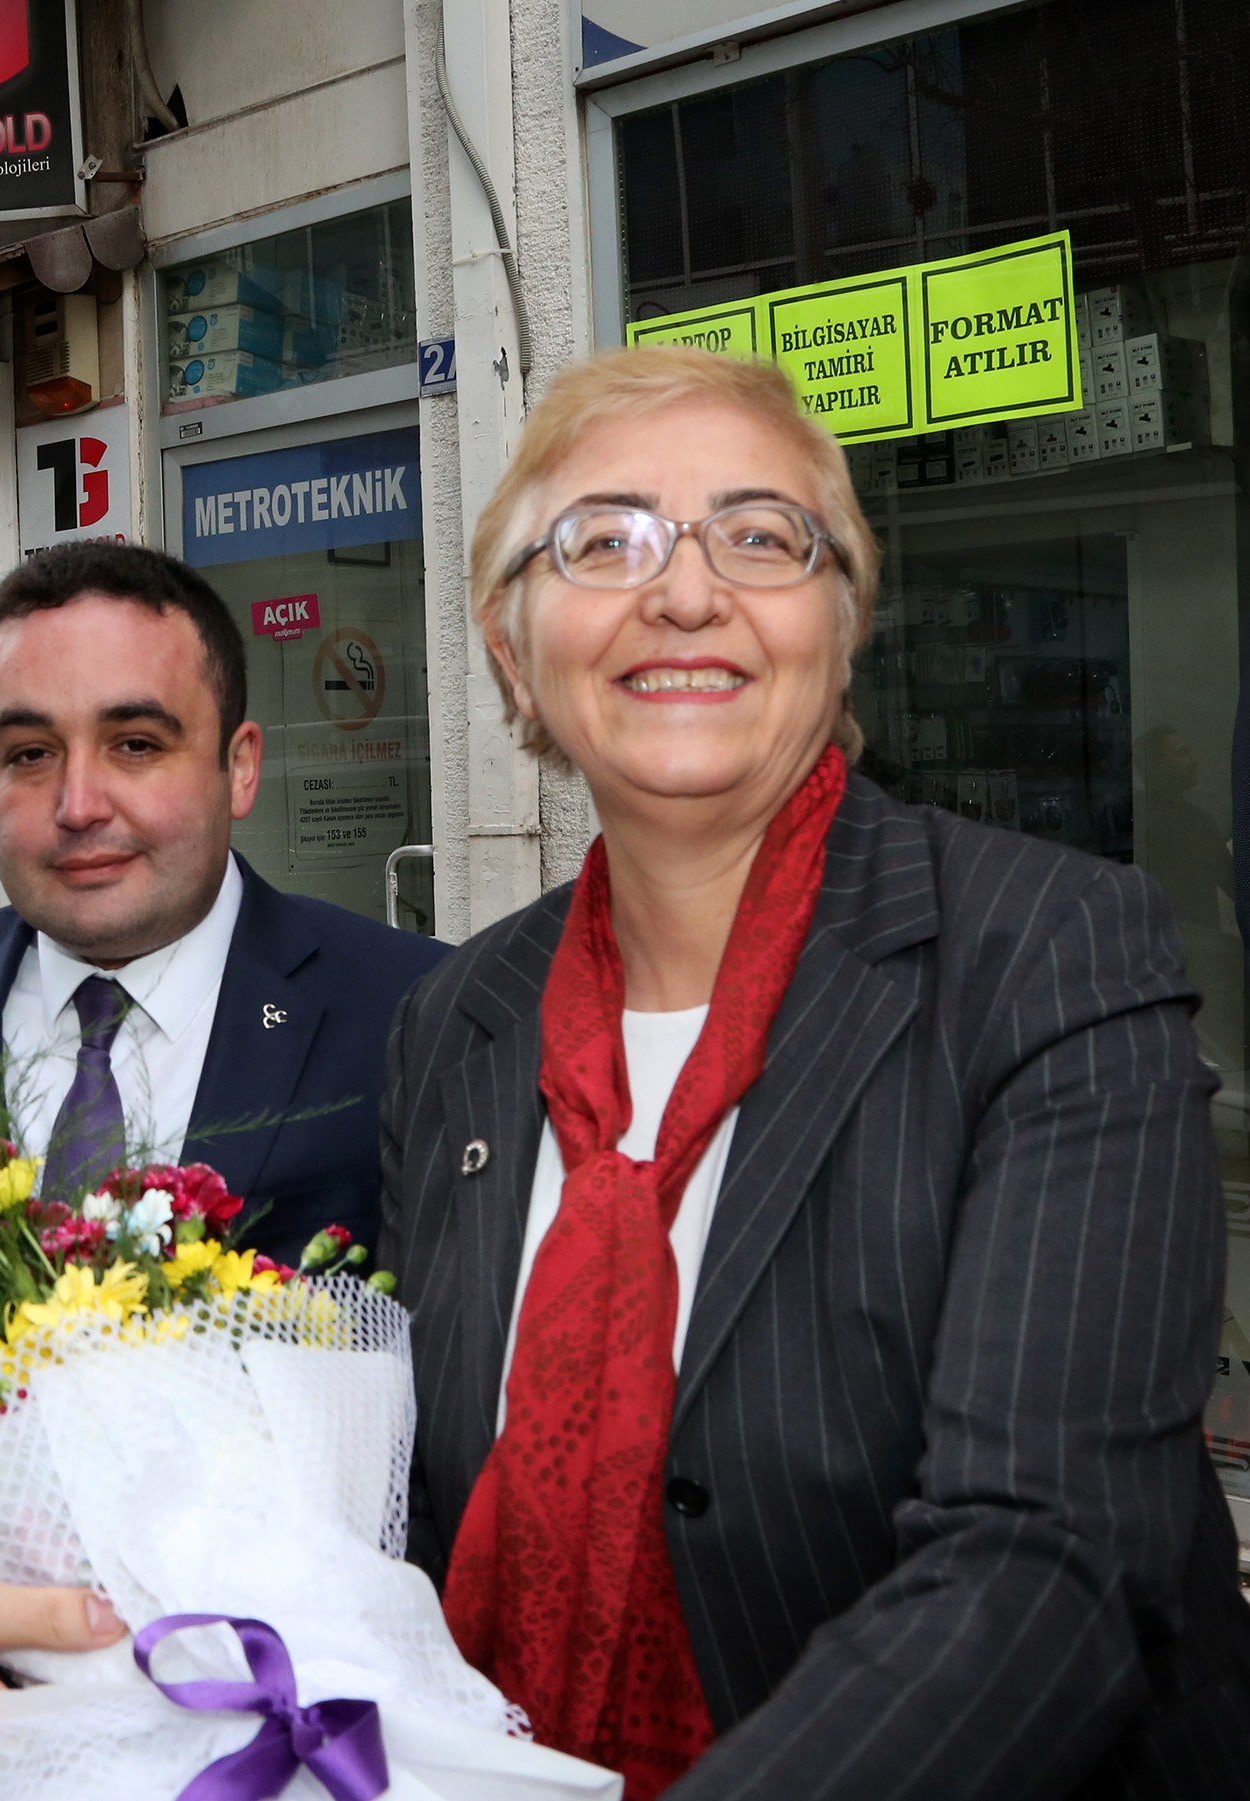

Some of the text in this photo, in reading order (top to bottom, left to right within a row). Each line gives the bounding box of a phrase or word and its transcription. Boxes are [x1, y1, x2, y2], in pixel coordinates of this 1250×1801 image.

[781, 314, 898, 352] BİLGİSAYAR
[930, 297, 1064, 344] FORMAT
[804, 345, 876, 381] TAMİRİ
[944, 339, 1052, 380] ATILIR
[801, 385, 881, 415] YAPILIR
[263, 601, 310, 626] AÇIK
[327, 829, 340, 840] 153
[353, 827, 366, 839] 155
